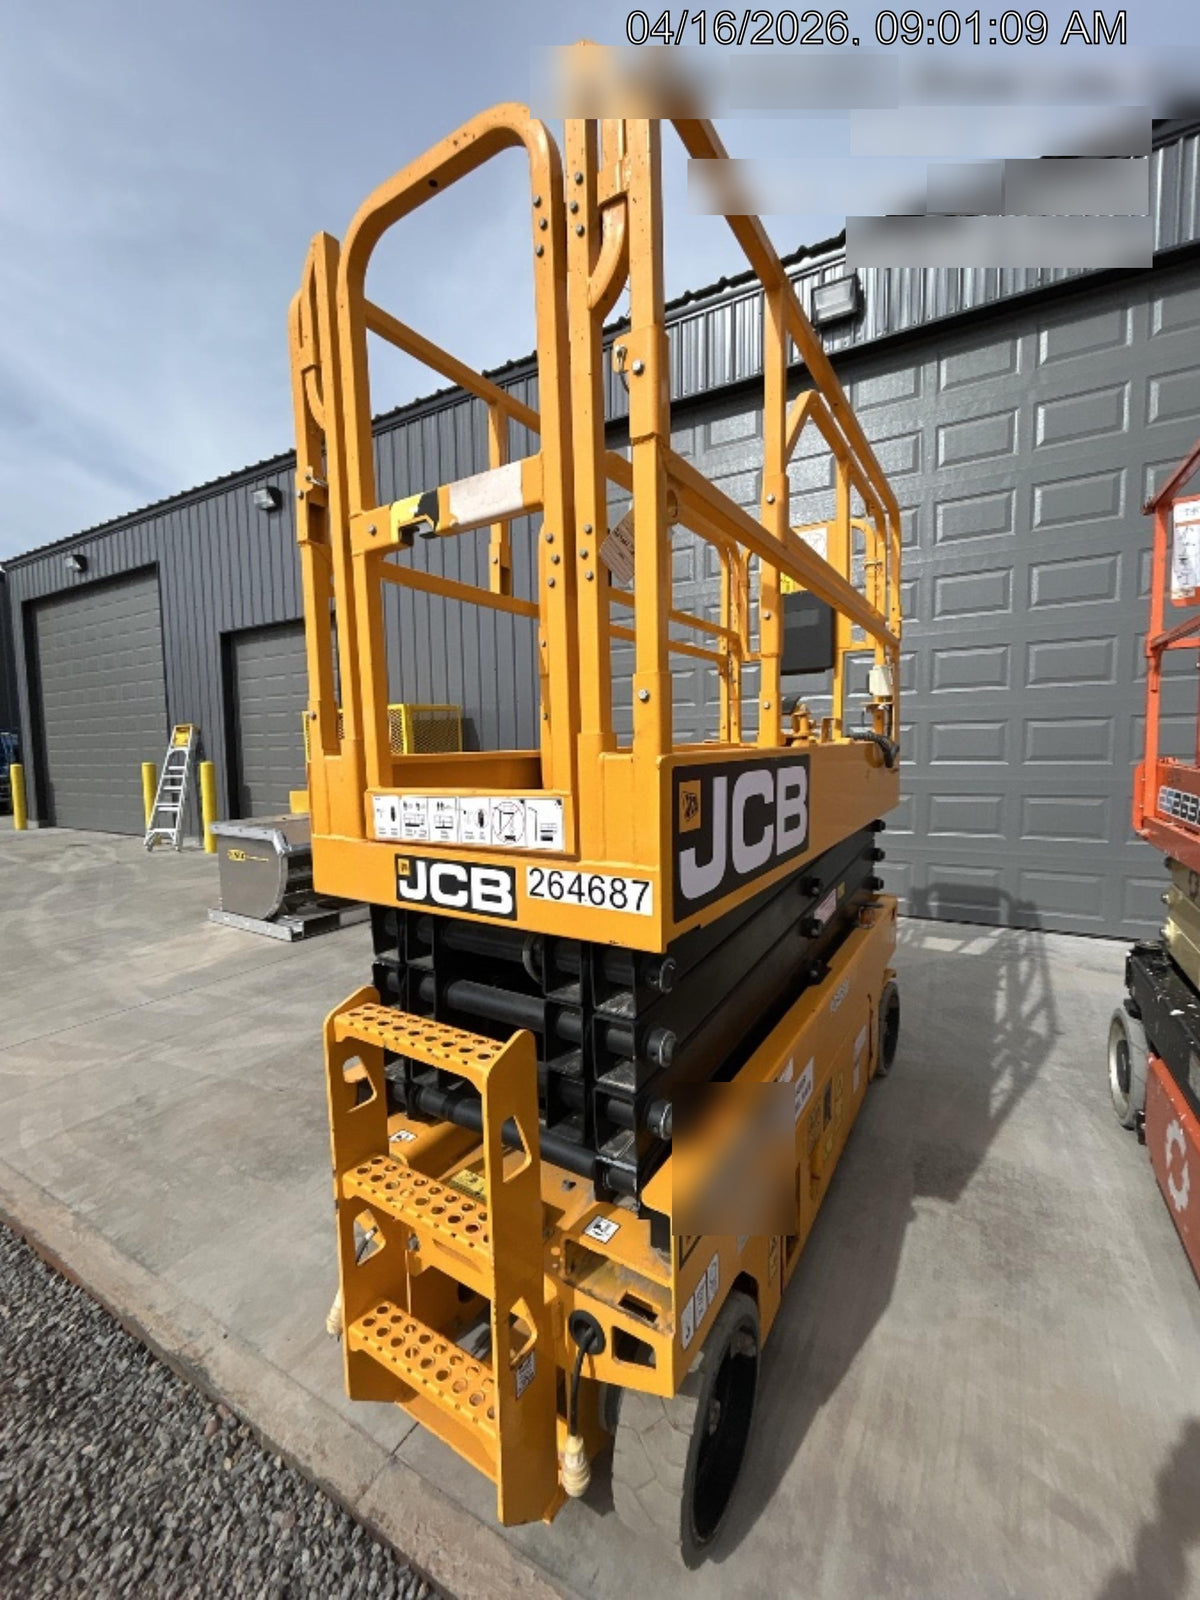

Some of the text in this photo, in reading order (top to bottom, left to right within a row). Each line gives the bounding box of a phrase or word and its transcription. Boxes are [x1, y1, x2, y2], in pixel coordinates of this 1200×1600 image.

[679, 765, 808, 900] JCB
[398, 860, 513, 914] JCB
[528, 867, 651, 912] 264687
